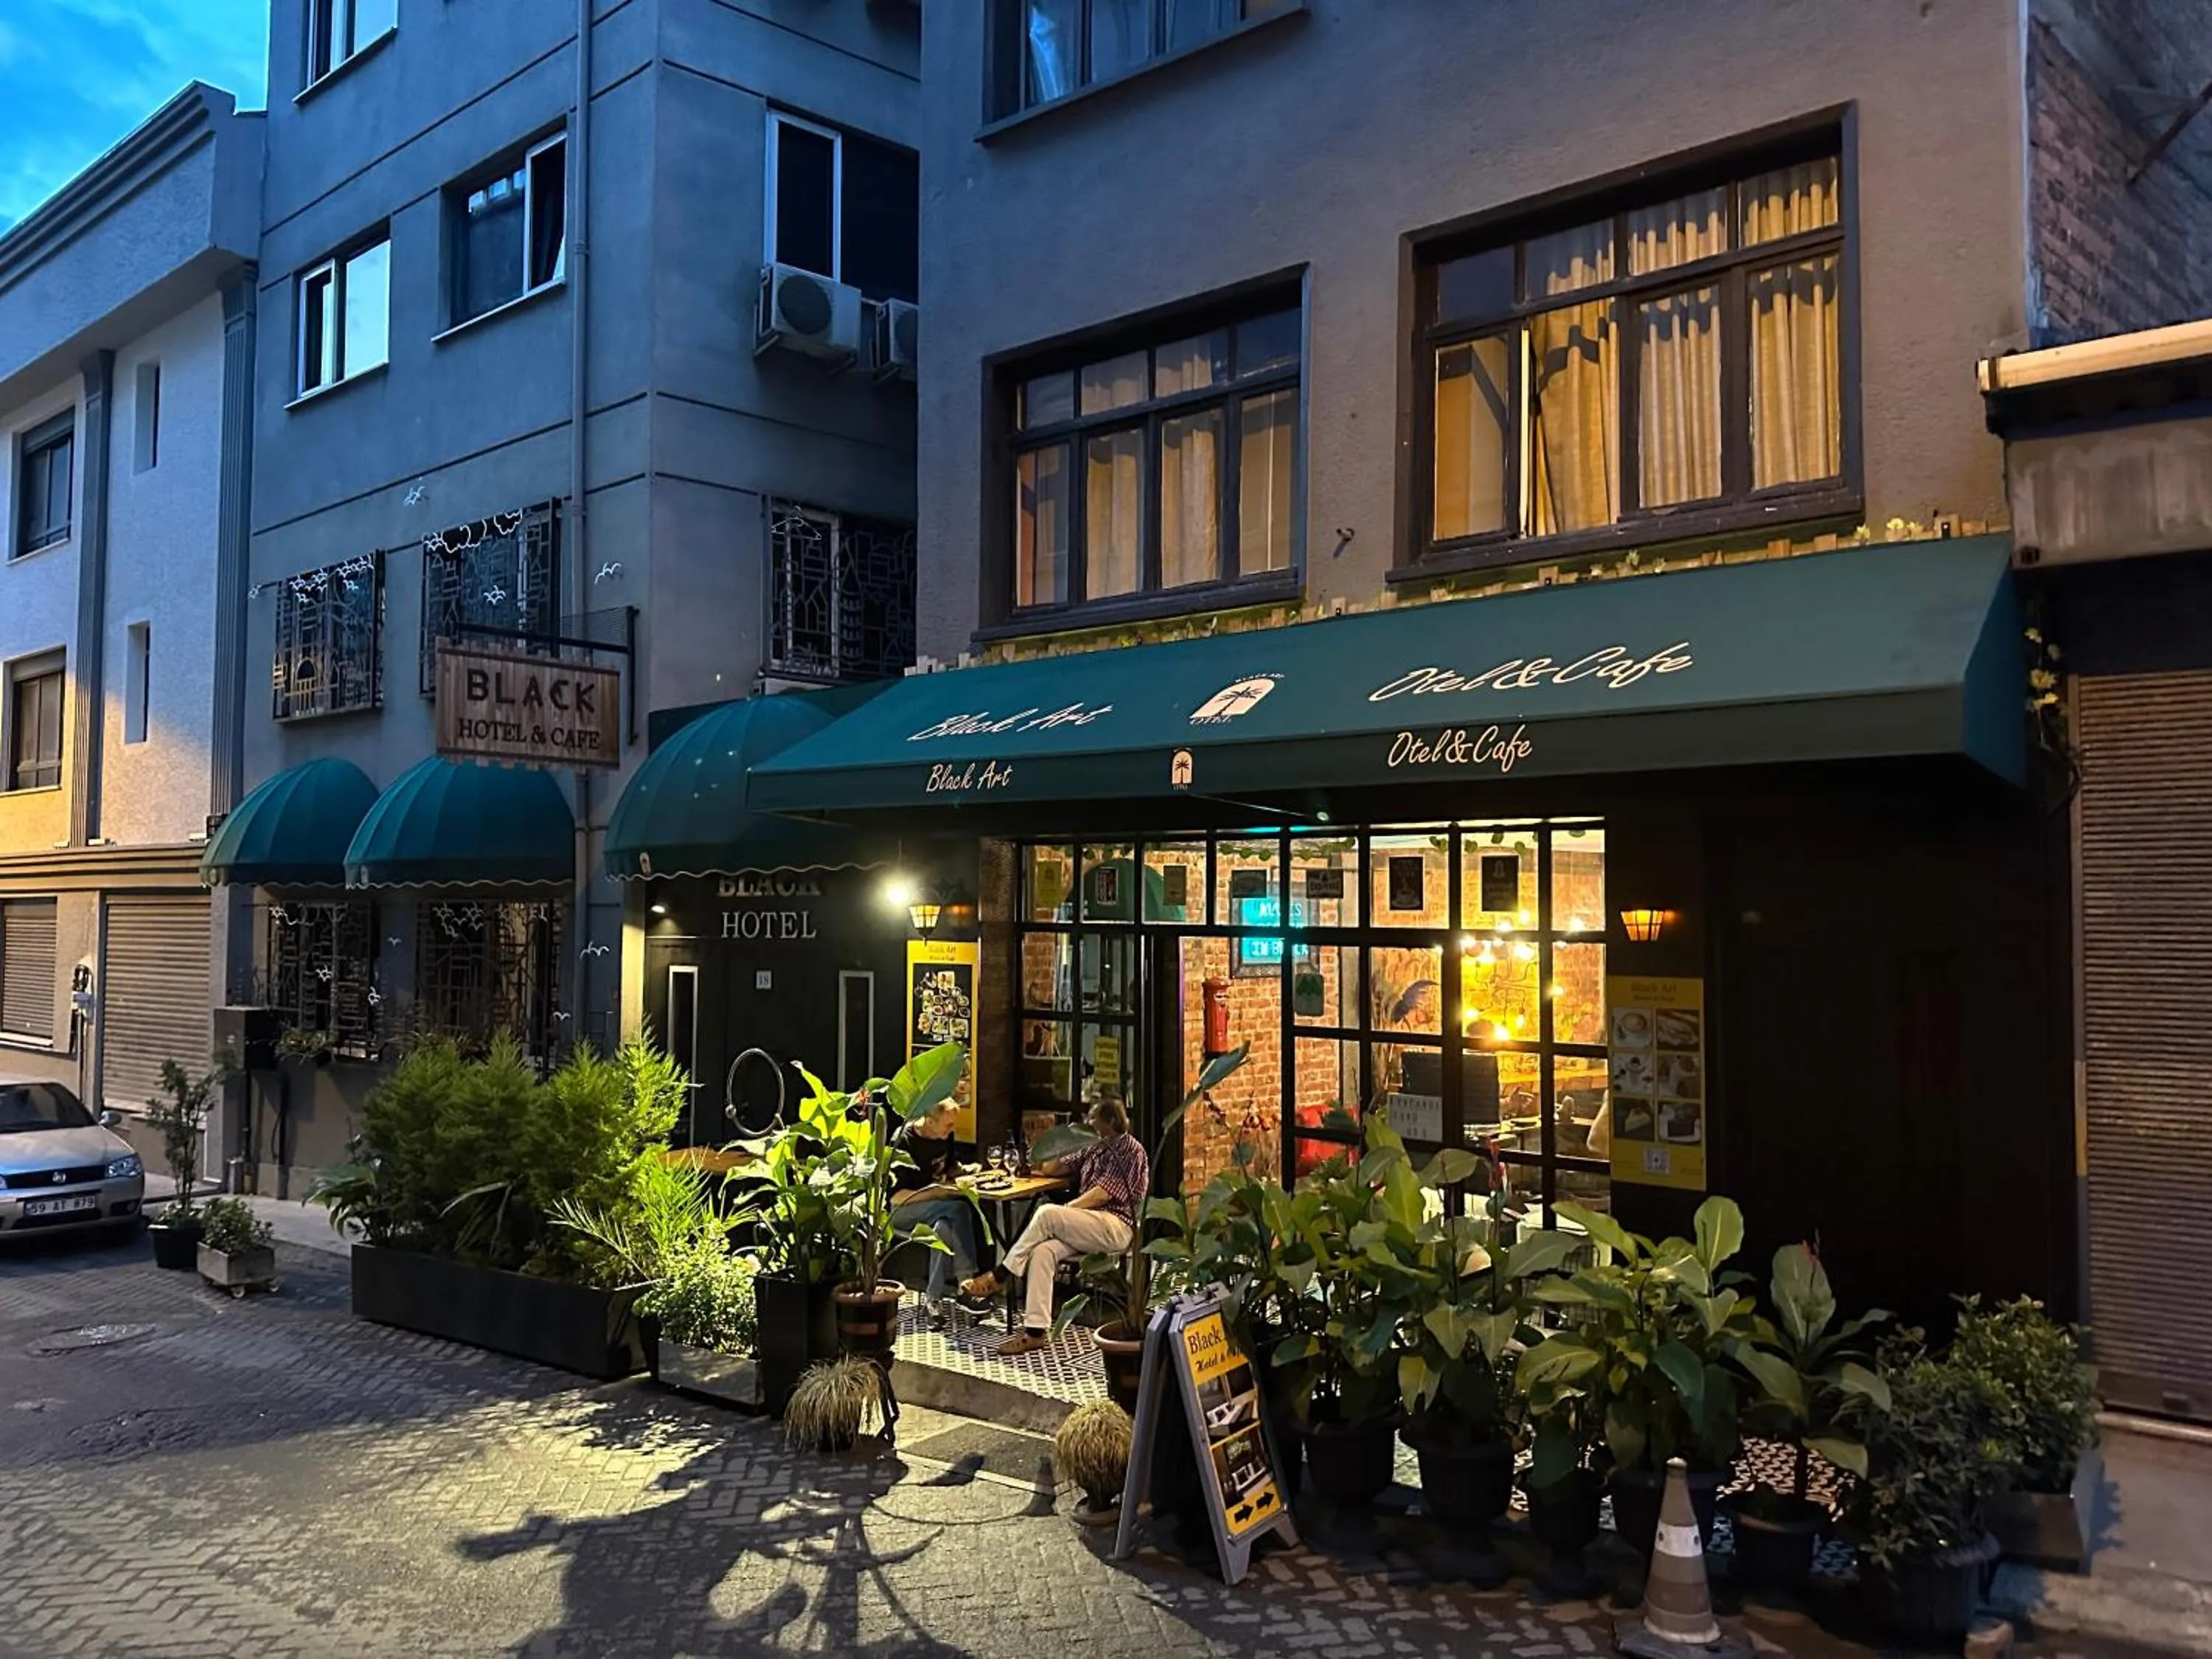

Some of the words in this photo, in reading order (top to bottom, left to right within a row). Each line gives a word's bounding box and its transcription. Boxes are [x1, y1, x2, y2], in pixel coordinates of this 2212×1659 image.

[467, 668, 594, 713] BLACK
[458, 717, 527, 744] HOTEL
[532, 726, 548, 745] &
[552, 727, 601, 751] CAFE
[926, 762, 975, 793] Black
[978, 760, 1012, 790] Art
[720, 911, 817, 939] HOTEL
[1188, 1324, 1222, 1355] Black
